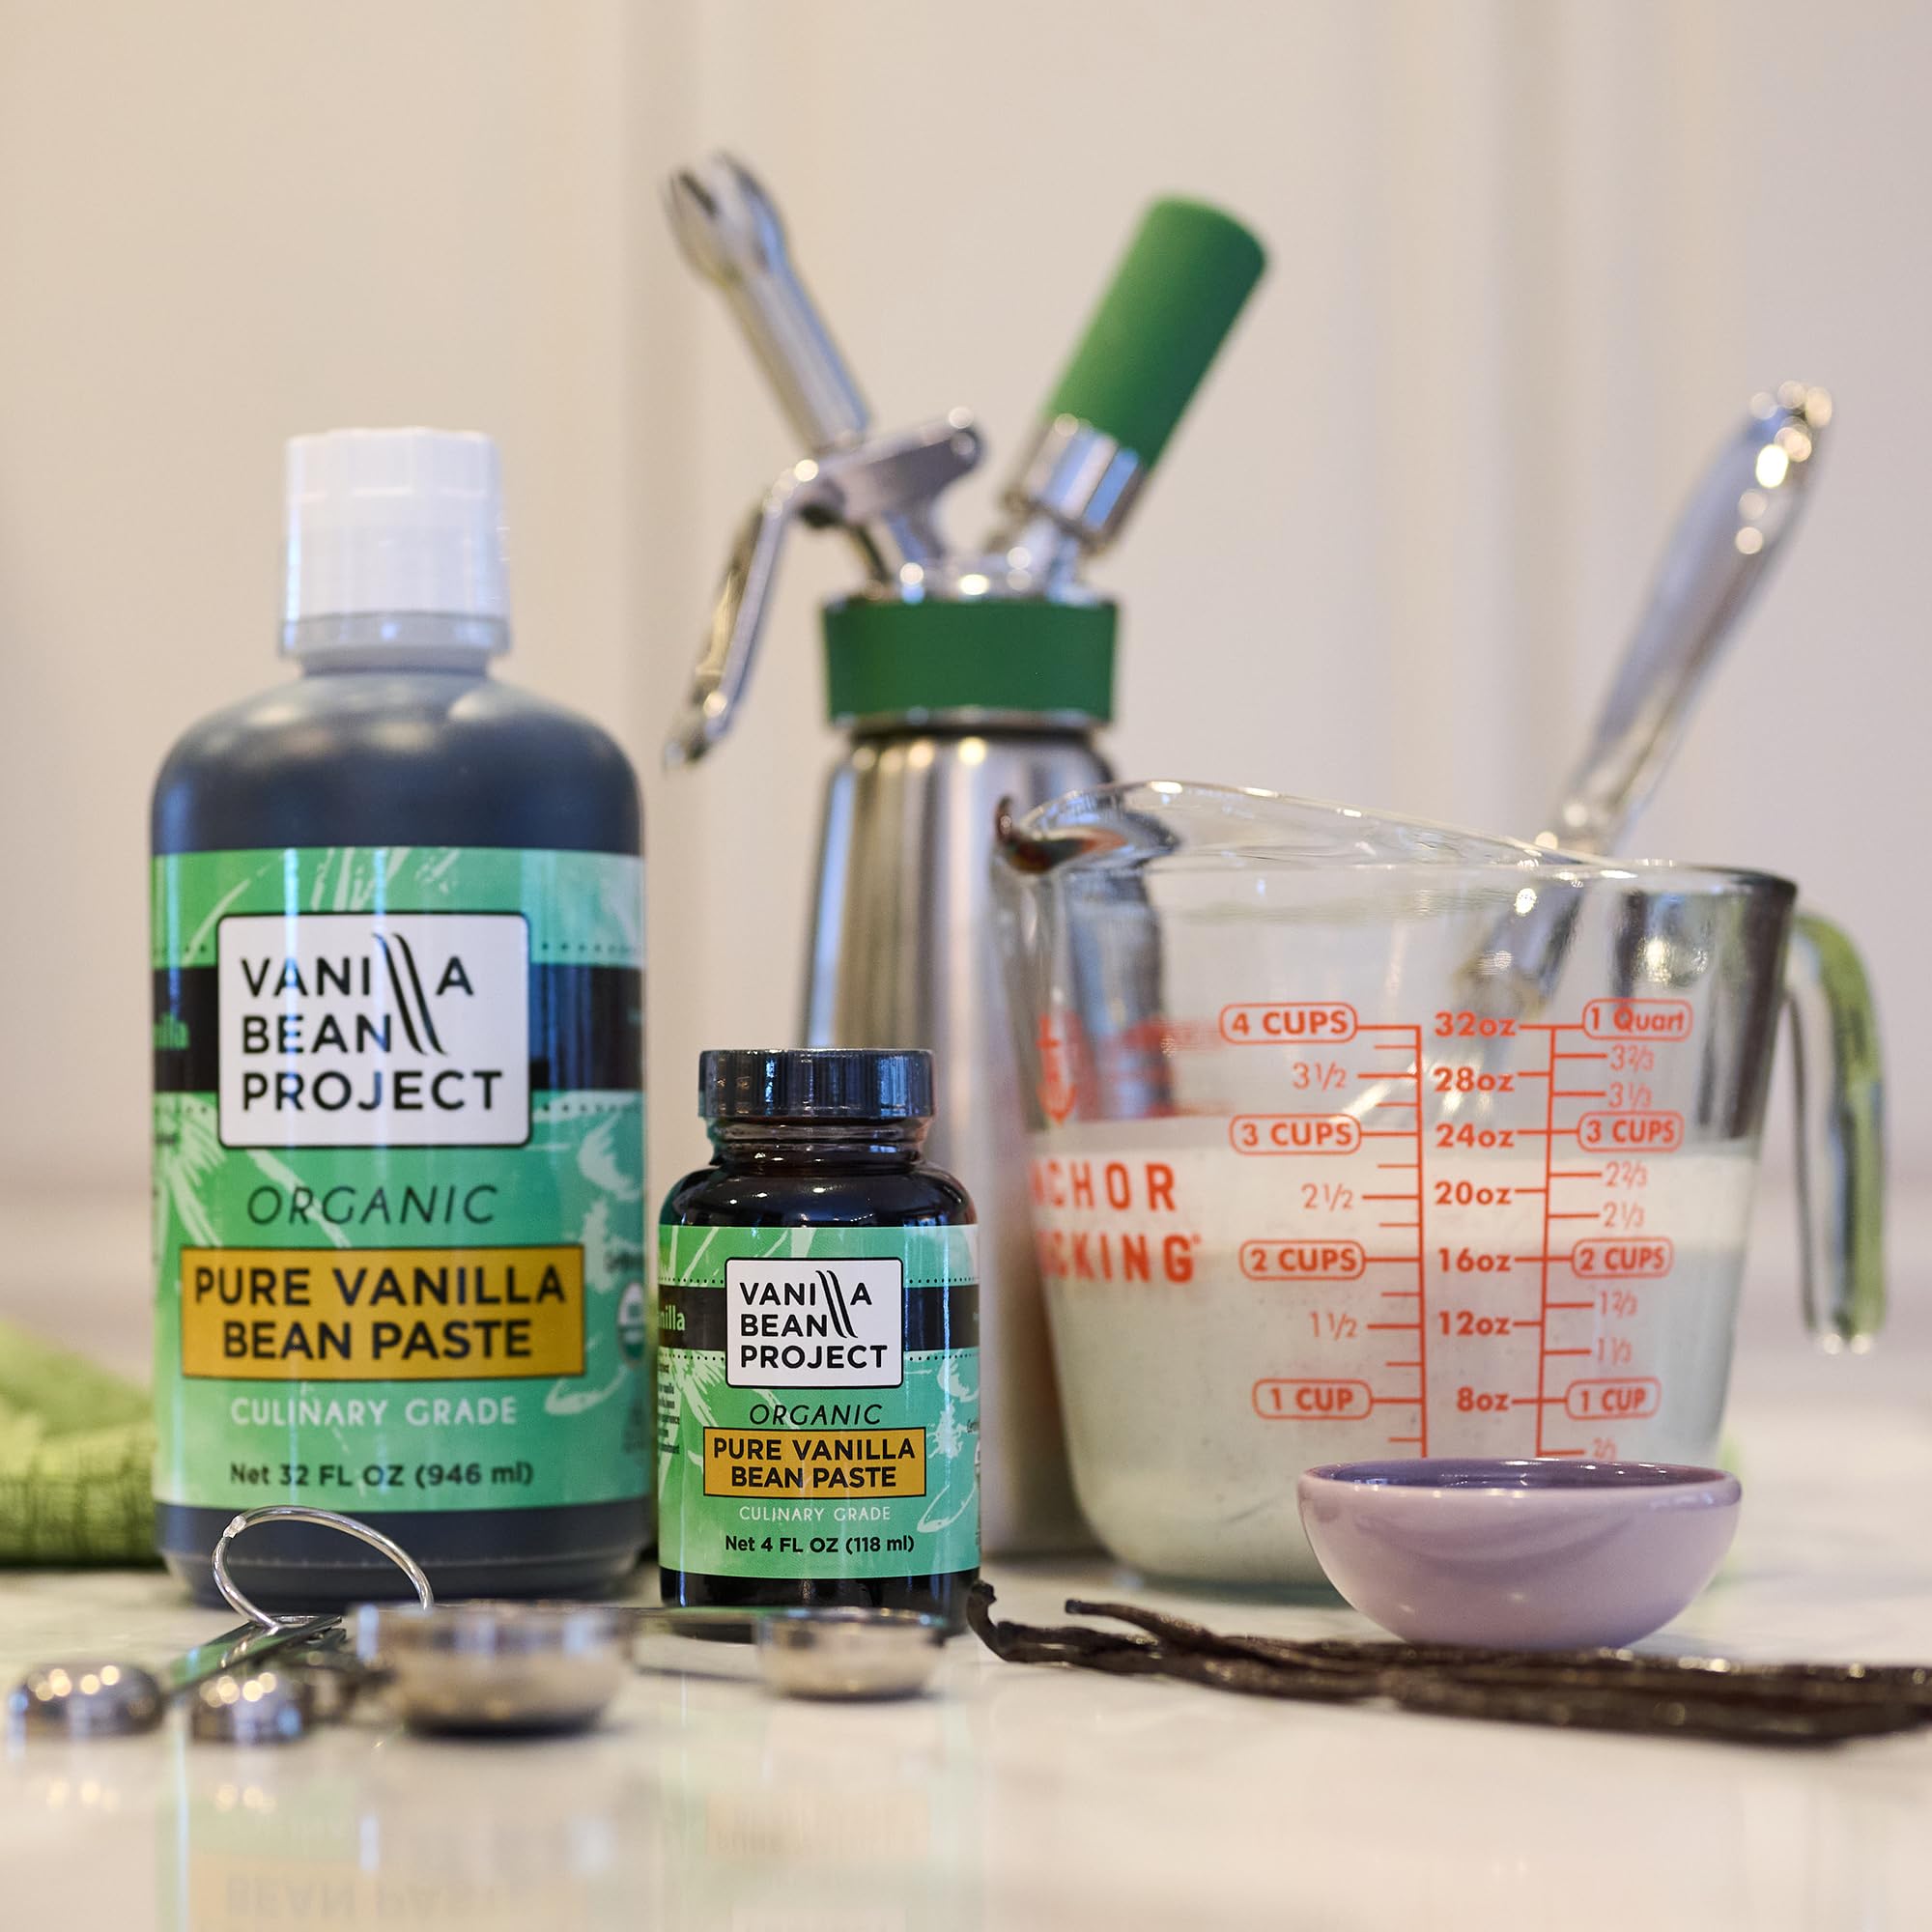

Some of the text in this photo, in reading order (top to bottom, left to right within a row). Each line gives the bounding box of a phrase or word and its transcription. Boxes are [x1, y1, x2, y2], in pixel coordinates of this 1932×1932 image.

[1233, 1009, 1349, 1036] 4 CUPS
[1435, 1010, 1517, 1037] 32oz
[1591, 1005, 1685, 1034] 1 Quart
[242, 1013, 392, 1056] BEAN
[242, 1069, 503, 1112] PROJECT
[1435, 1066, 1515, 1093] 28oz
[1242, 1121, 1352, 1147] 3 CUPS
[1436, 1123, 1515, 1149] 24oz
[1586, 1120, 1674, 1144] 3 CUPS
[247, 1184, 497, 1226] ORGANIC
[1435, 1181, 1513, 1206] 20oz
[1251, 1247, 1357, 1272] 2 CUPS
[1439, 1247, 1512, 1271] 16oz
[1579, 1246, 1663, 1270] 2 CUPS
[195, 1264, 565, 1307] PURE VANILLA
[740, 1314, 828, 1338] BEAN
[1439, 1311, 1511, 1336] 12oz
[223, 1319, 532, 1359] BEAN PASTE
[740, 1345, 888, 1369] PROJECT
[230, 1396, 518, 1427] CULINARY GRADE
[1271, 1387, 1353, 1411] 1 CUP
[1457, 1387, 1510, 1411] 8oz
[1581, 1388, 1647, 1412] 1 CUP
[749, 1404, 883, 1426] ORGANIC
[713, 1436, 916, 1462] PURE VANILLA
[230, 1461, 534, 1489] Net 32 FL OZ (946 ml)
[731, 1466, 897, 1489] BEAN PASTE
[739, 1506, 891, 1522] CULINARY GRADE
[725, 1534, 915, 1555] Net 4 FL OZ (118 ml)
